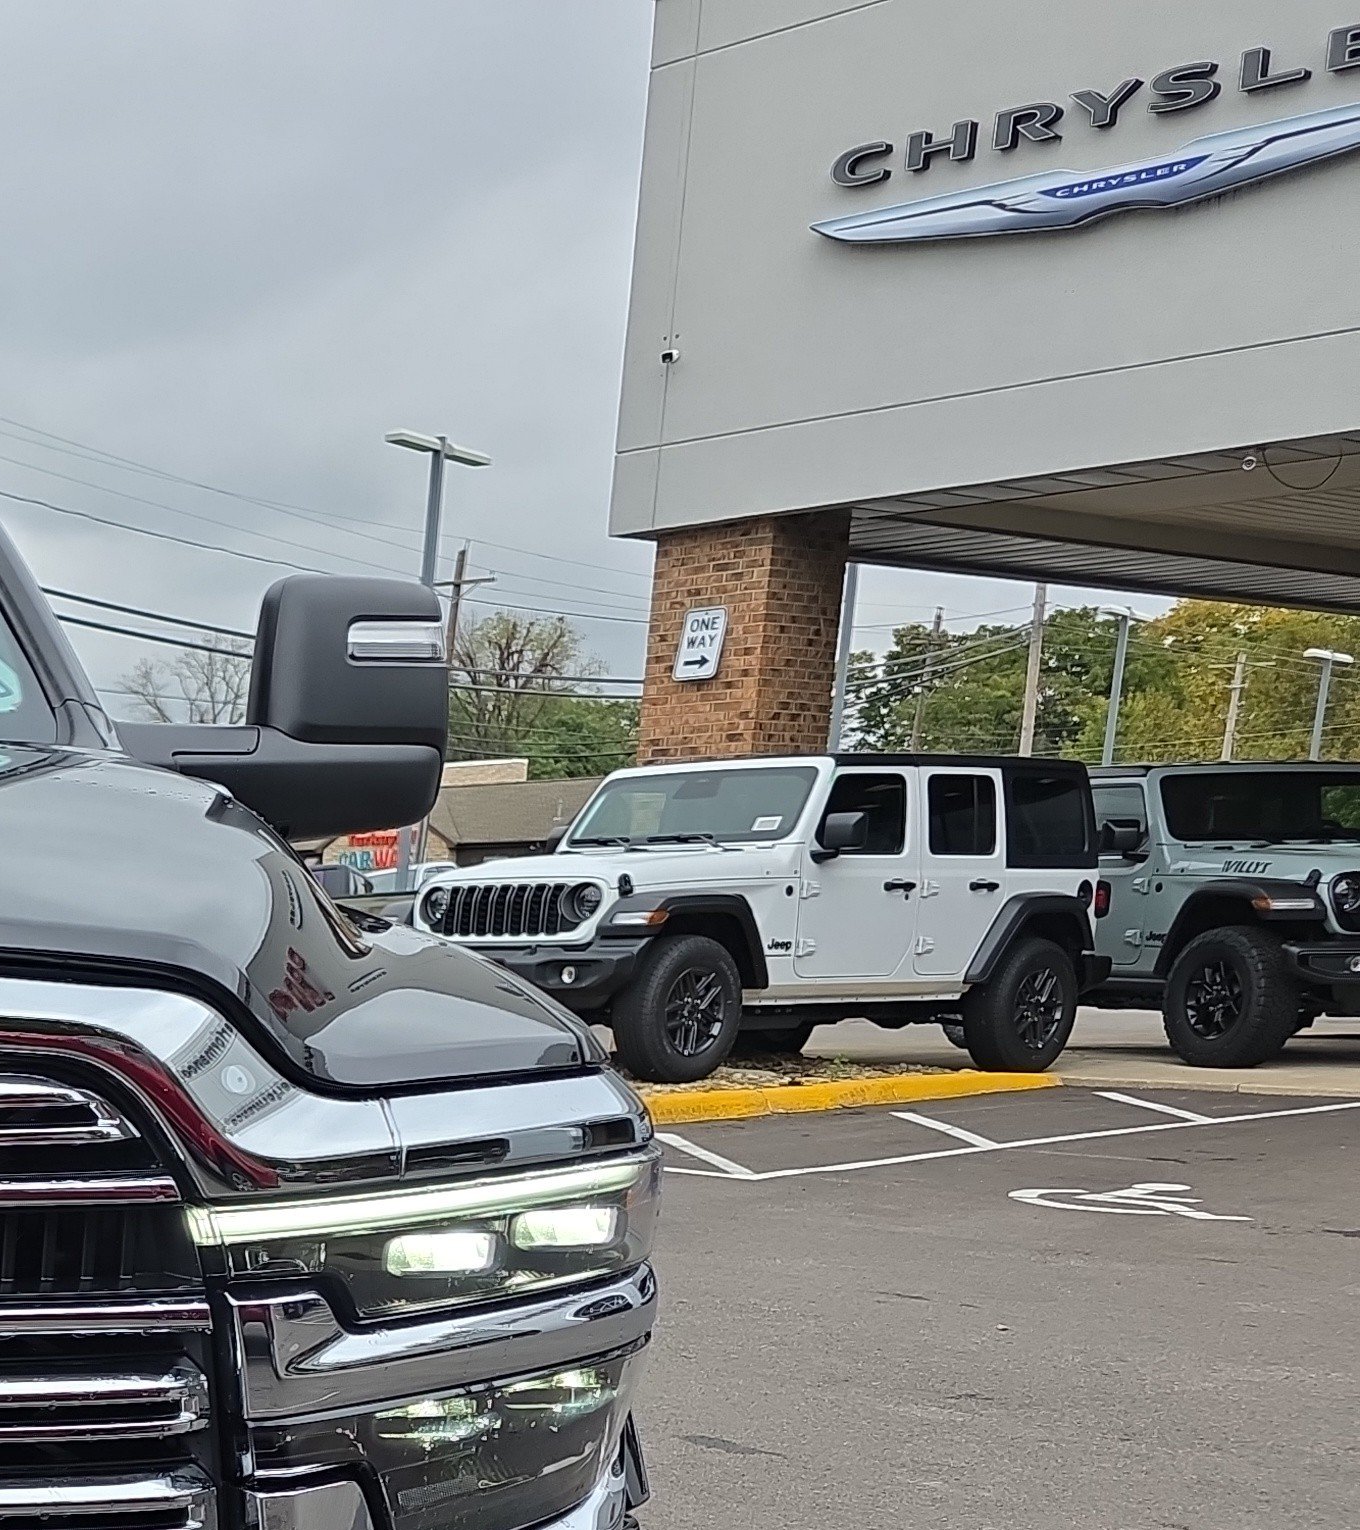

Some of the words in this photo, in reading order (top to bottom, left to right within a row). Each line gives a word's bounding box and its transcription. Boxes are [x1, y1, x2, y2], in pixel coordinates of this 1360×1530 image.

[1055, 163, 1187, 197] CHRYSLER
[690, 616, 720, 632] ONE
[687, 634, 717, 649] WAY
[1221, 860, 1272, 874] WILLYS
[767, 938, 792, 951] Jeep
